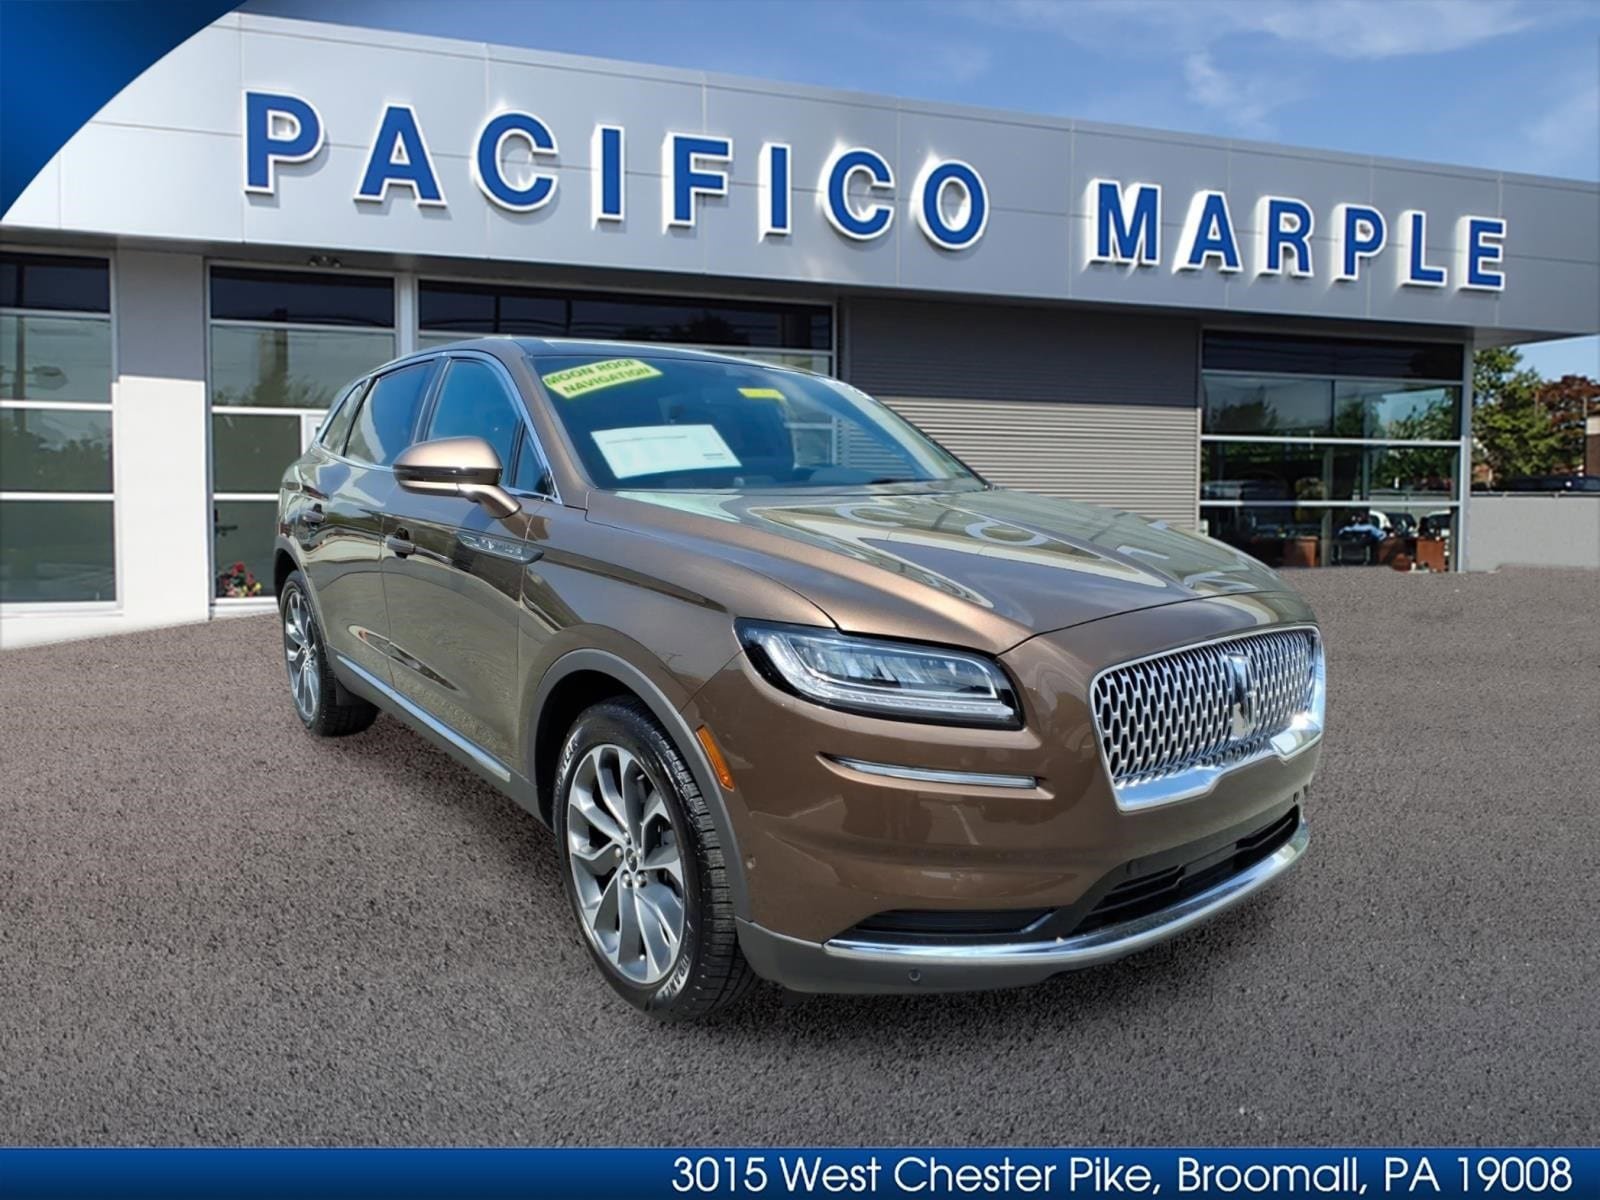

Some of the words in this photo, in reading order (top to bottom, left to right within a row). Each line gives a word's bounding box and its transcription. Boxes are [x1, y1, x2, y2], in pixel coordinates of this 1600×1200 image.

[244, 90, 989, 249] PACIFICO
[1089, 180, 1507, 292] MARPLE
[544, 366, 594, 386] MOON
[562, 367, 651, 394] NAVIGATION
